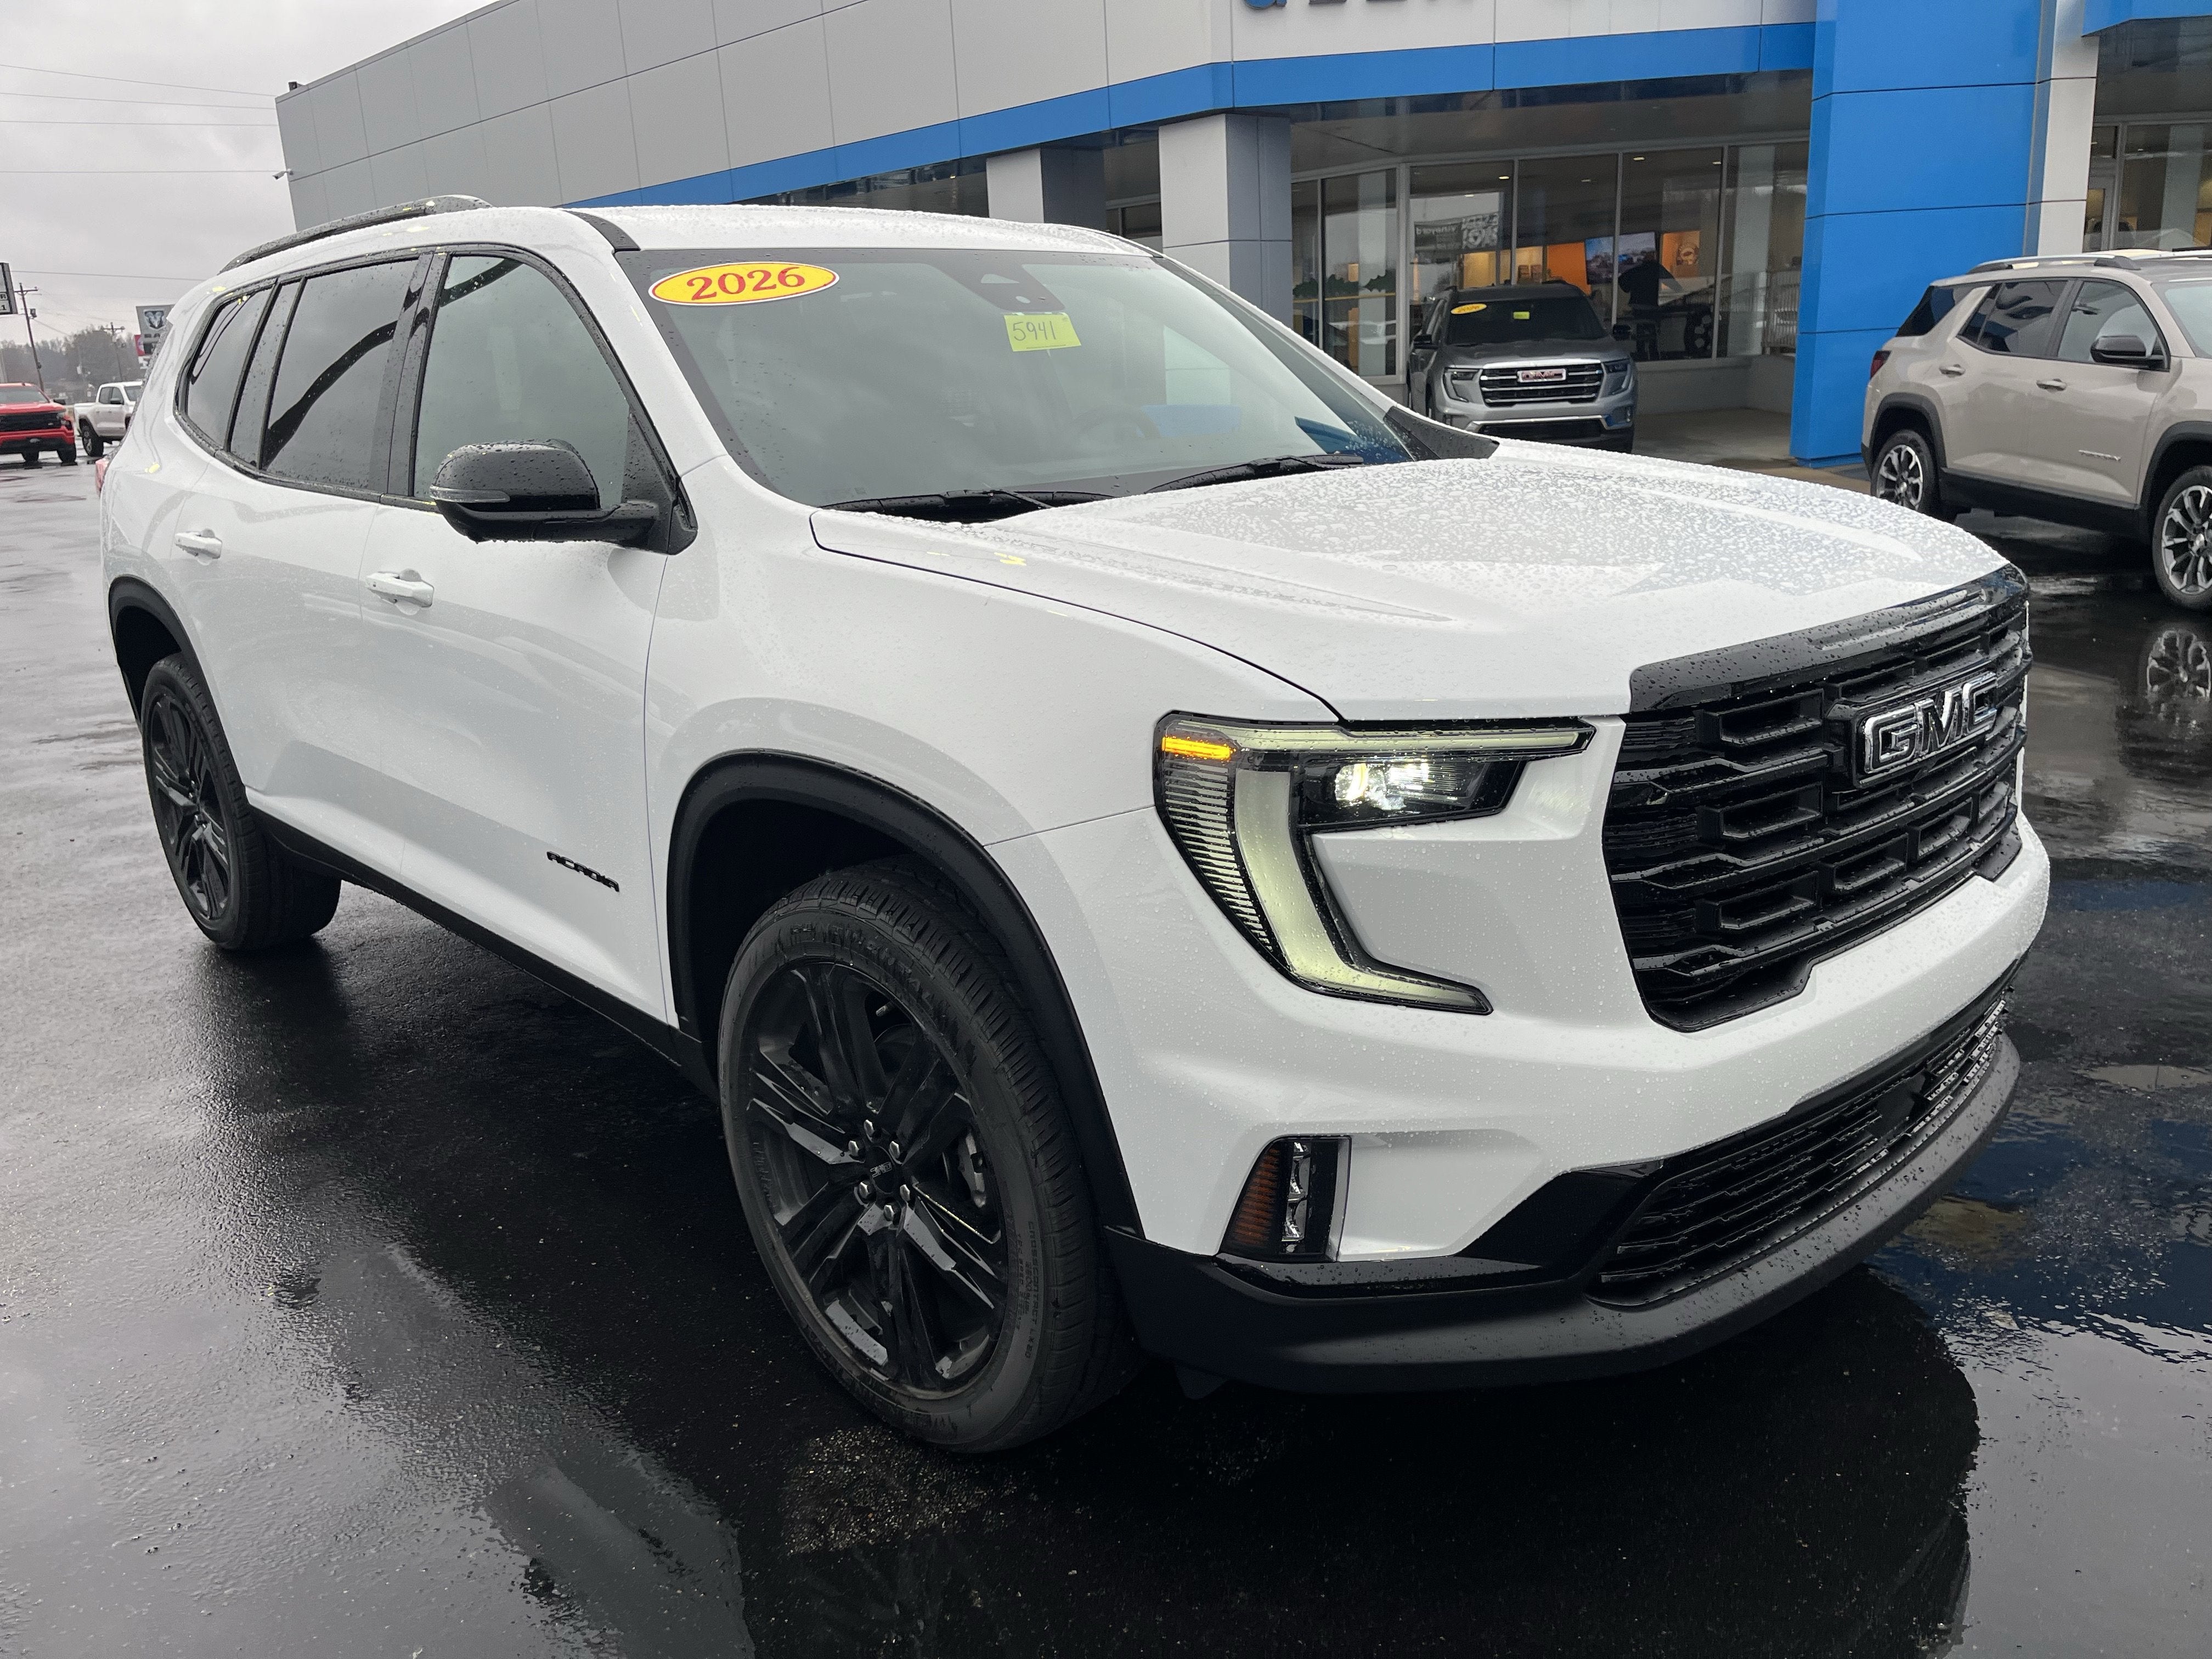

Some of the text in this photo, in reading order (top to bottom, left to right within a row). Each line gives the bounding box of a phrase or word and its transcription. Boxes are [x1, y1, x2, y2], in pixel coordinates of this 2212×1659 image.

[687, 267, 805, 301] 2026
[1013, 321, 1057, 341] 5941
[1865, 671, 1998, 774] GMC
